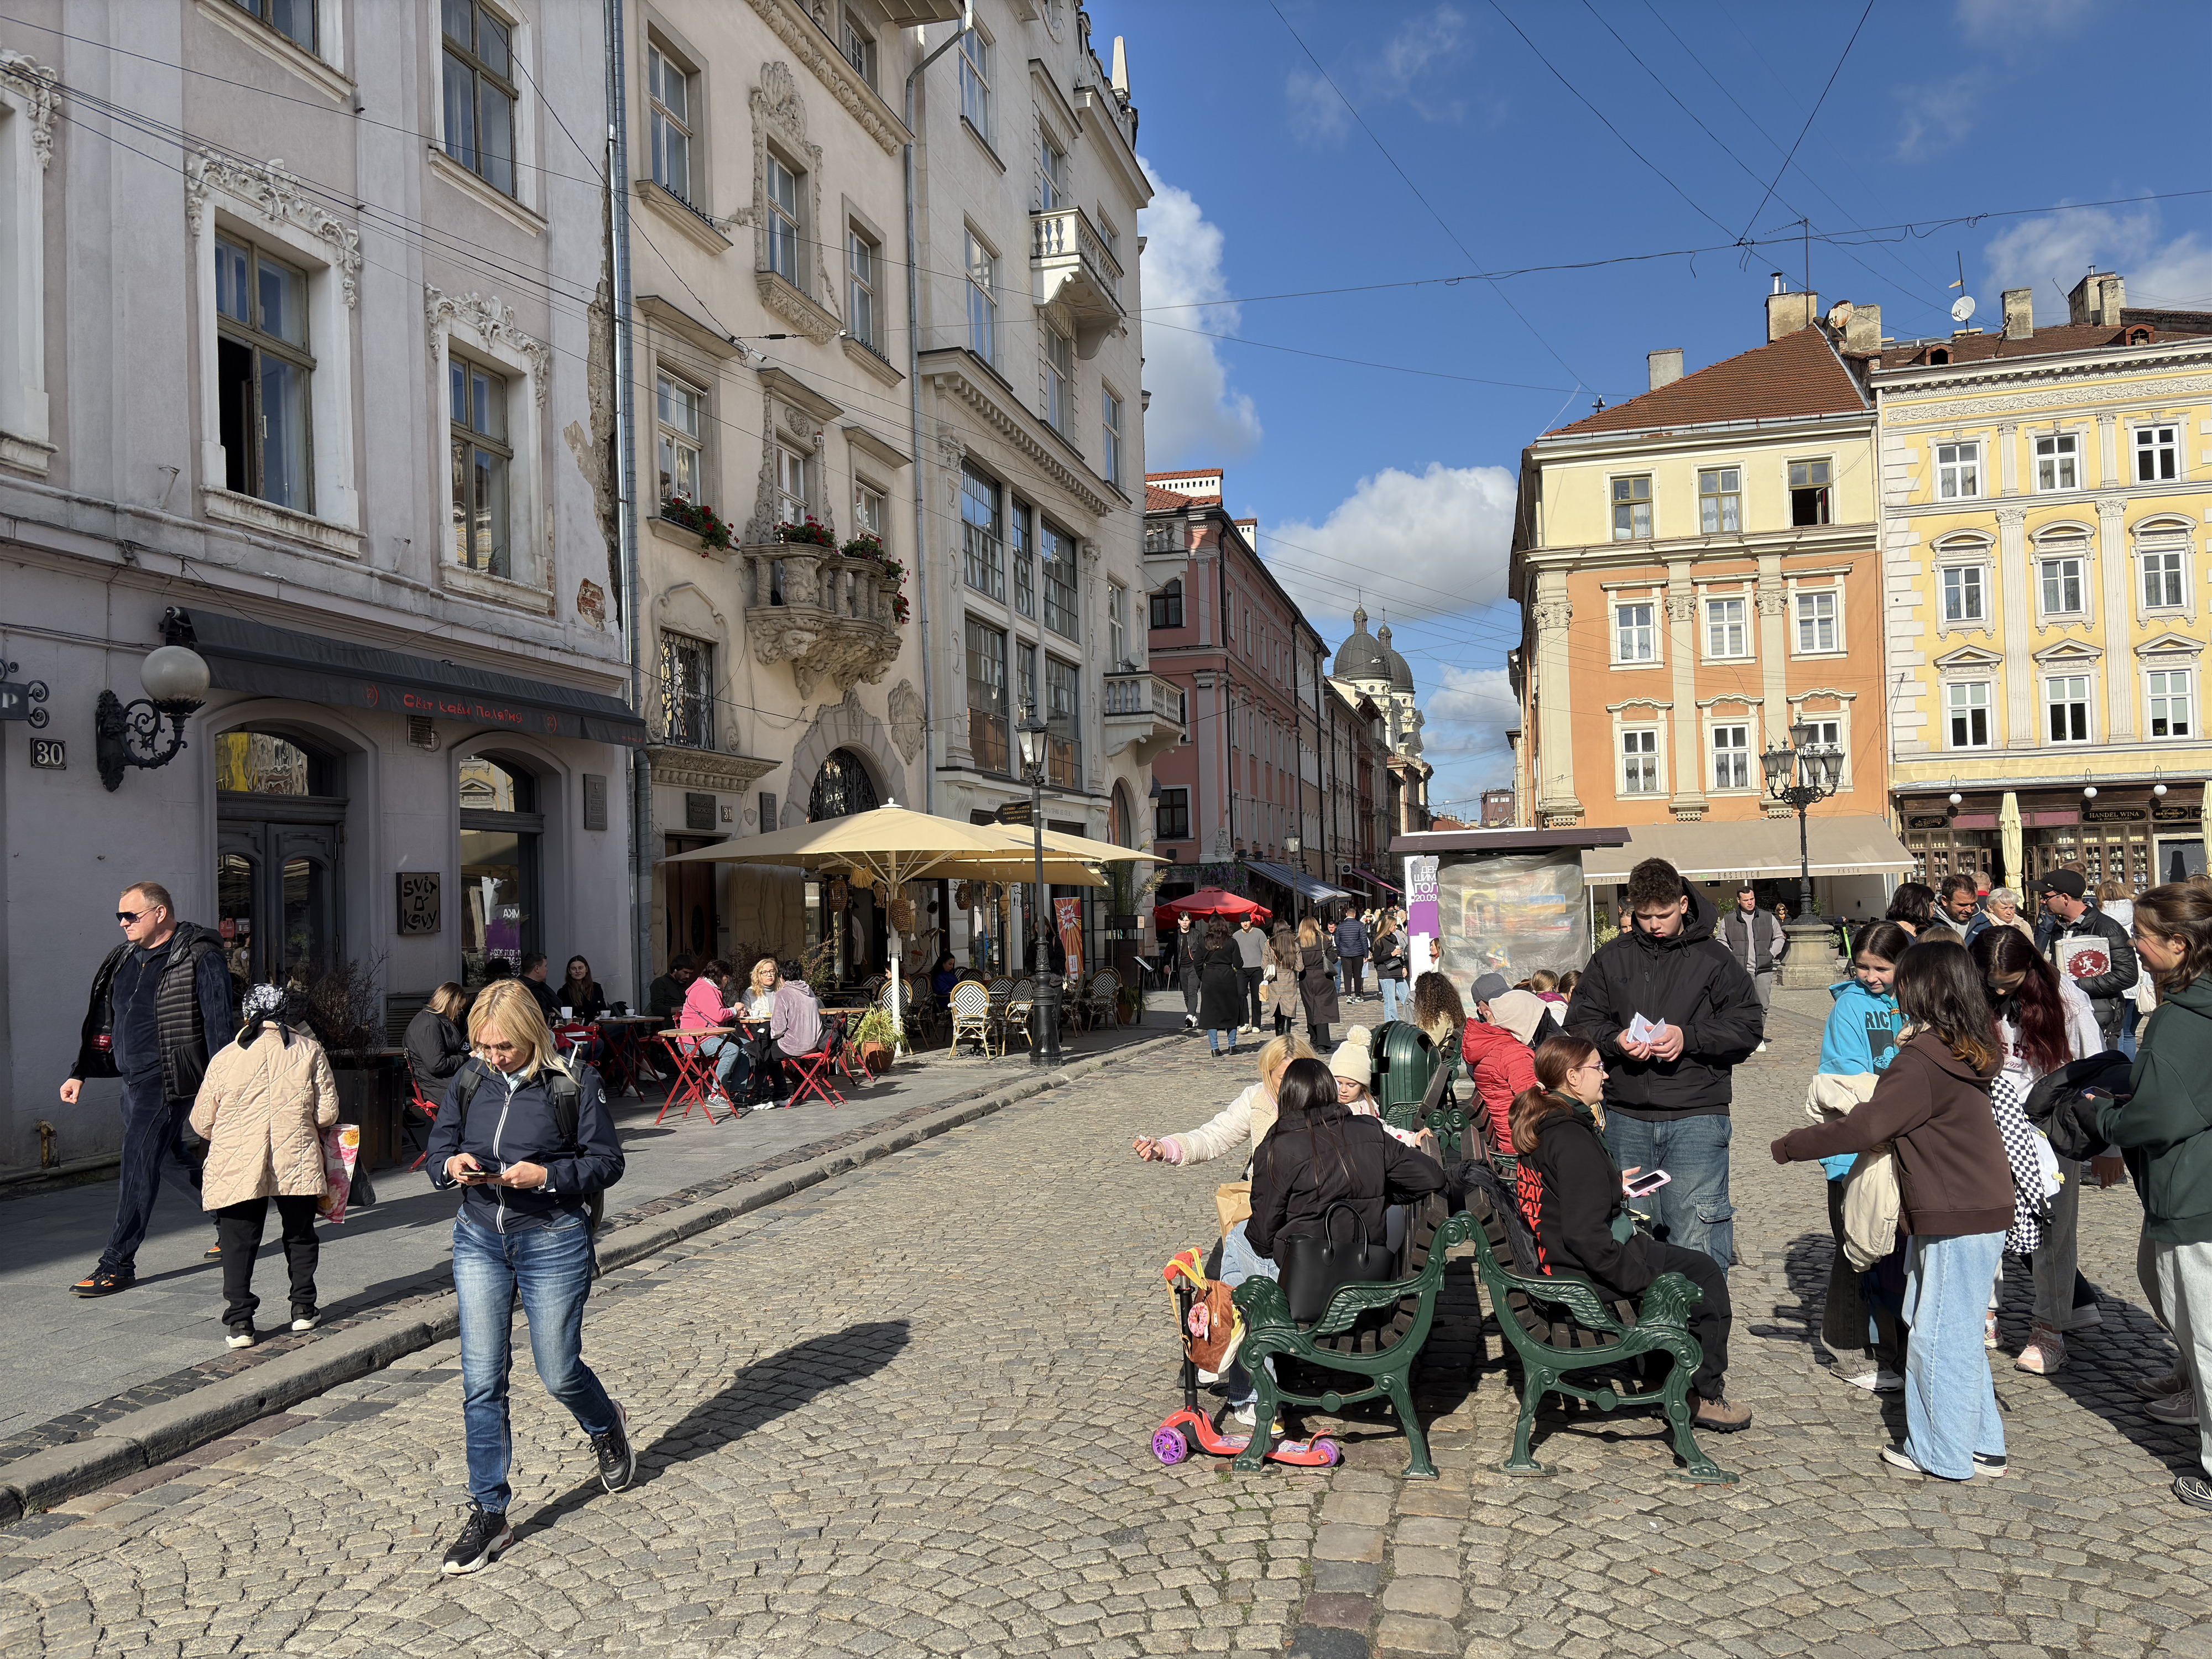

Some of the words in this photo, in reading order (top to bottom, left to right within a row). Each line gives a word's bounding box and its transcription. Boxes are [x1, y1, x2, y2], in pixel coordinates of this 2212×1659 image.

[37, 742, 63, 765] 30
[724, 807, 731, 820] 31
[1718, 871, 1760, 879] BASILICO
[1415, 894, 1437, 902] 20.09
